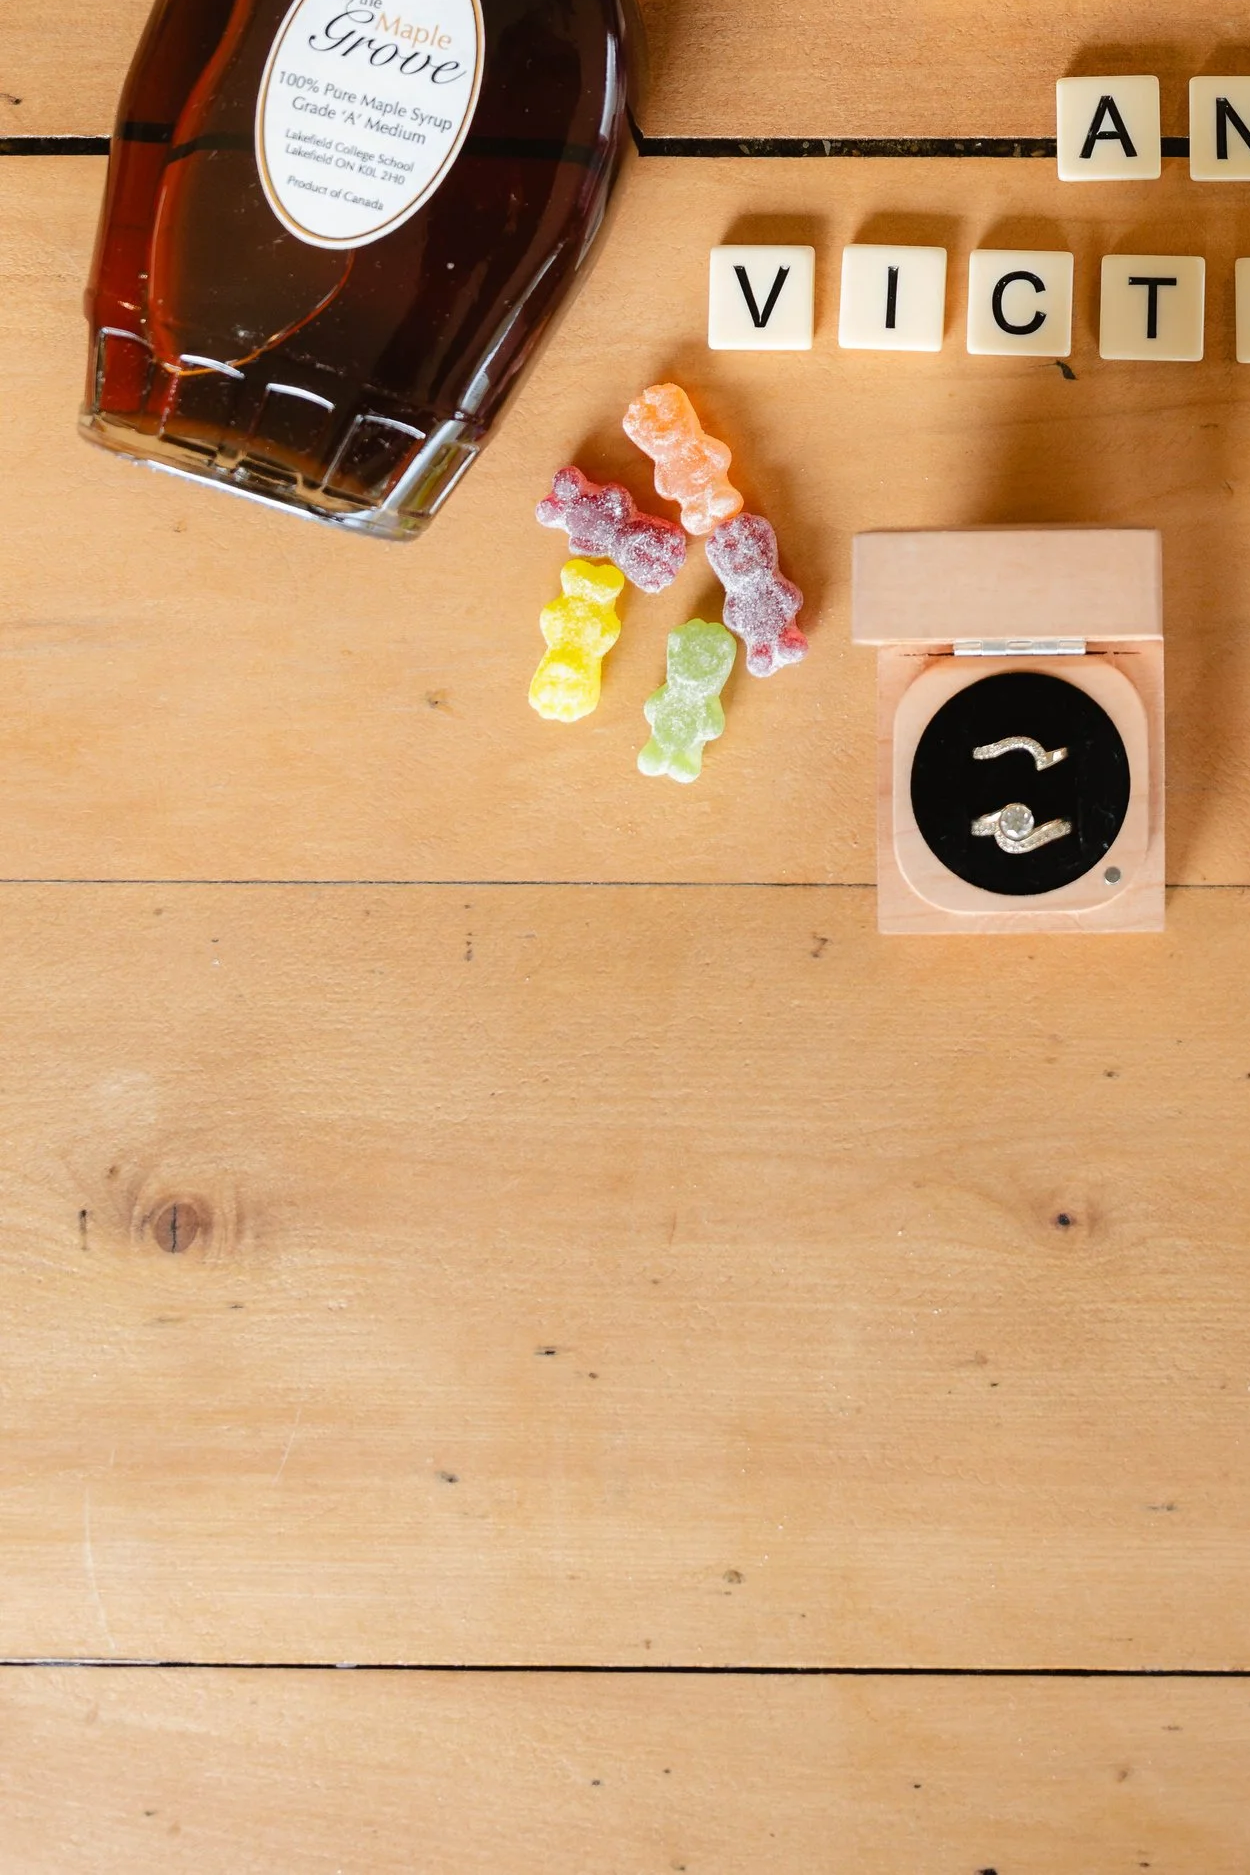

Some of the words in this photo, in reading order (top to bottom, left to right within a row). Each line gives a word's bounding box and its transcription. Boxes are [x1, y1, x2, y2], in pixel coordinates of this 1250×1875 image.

[309, 3, 467, 84] Grove
[375, 12, 452, 50] Maple
[278, 70, 319, 93] 100%
[323, 83, 357, 104] Pure
[361, 95, 407, 118] Maple
[411, 107, 453, 133] Syrup
[292, 96, 336, 119] Grade
[364, 117, 426, 145] Medium
[285, 128, 333, 150] Lakefield
[335, 141, 375, 162] College
[378, 153, 415, 172] School
[285, 143, 333, 165] Lakefield
[335, 157, 356, 171] ON
[286, 174, 328, 195] Product
[330, 188, 342, 199] of
[343, 190, 384, 211] Canada
